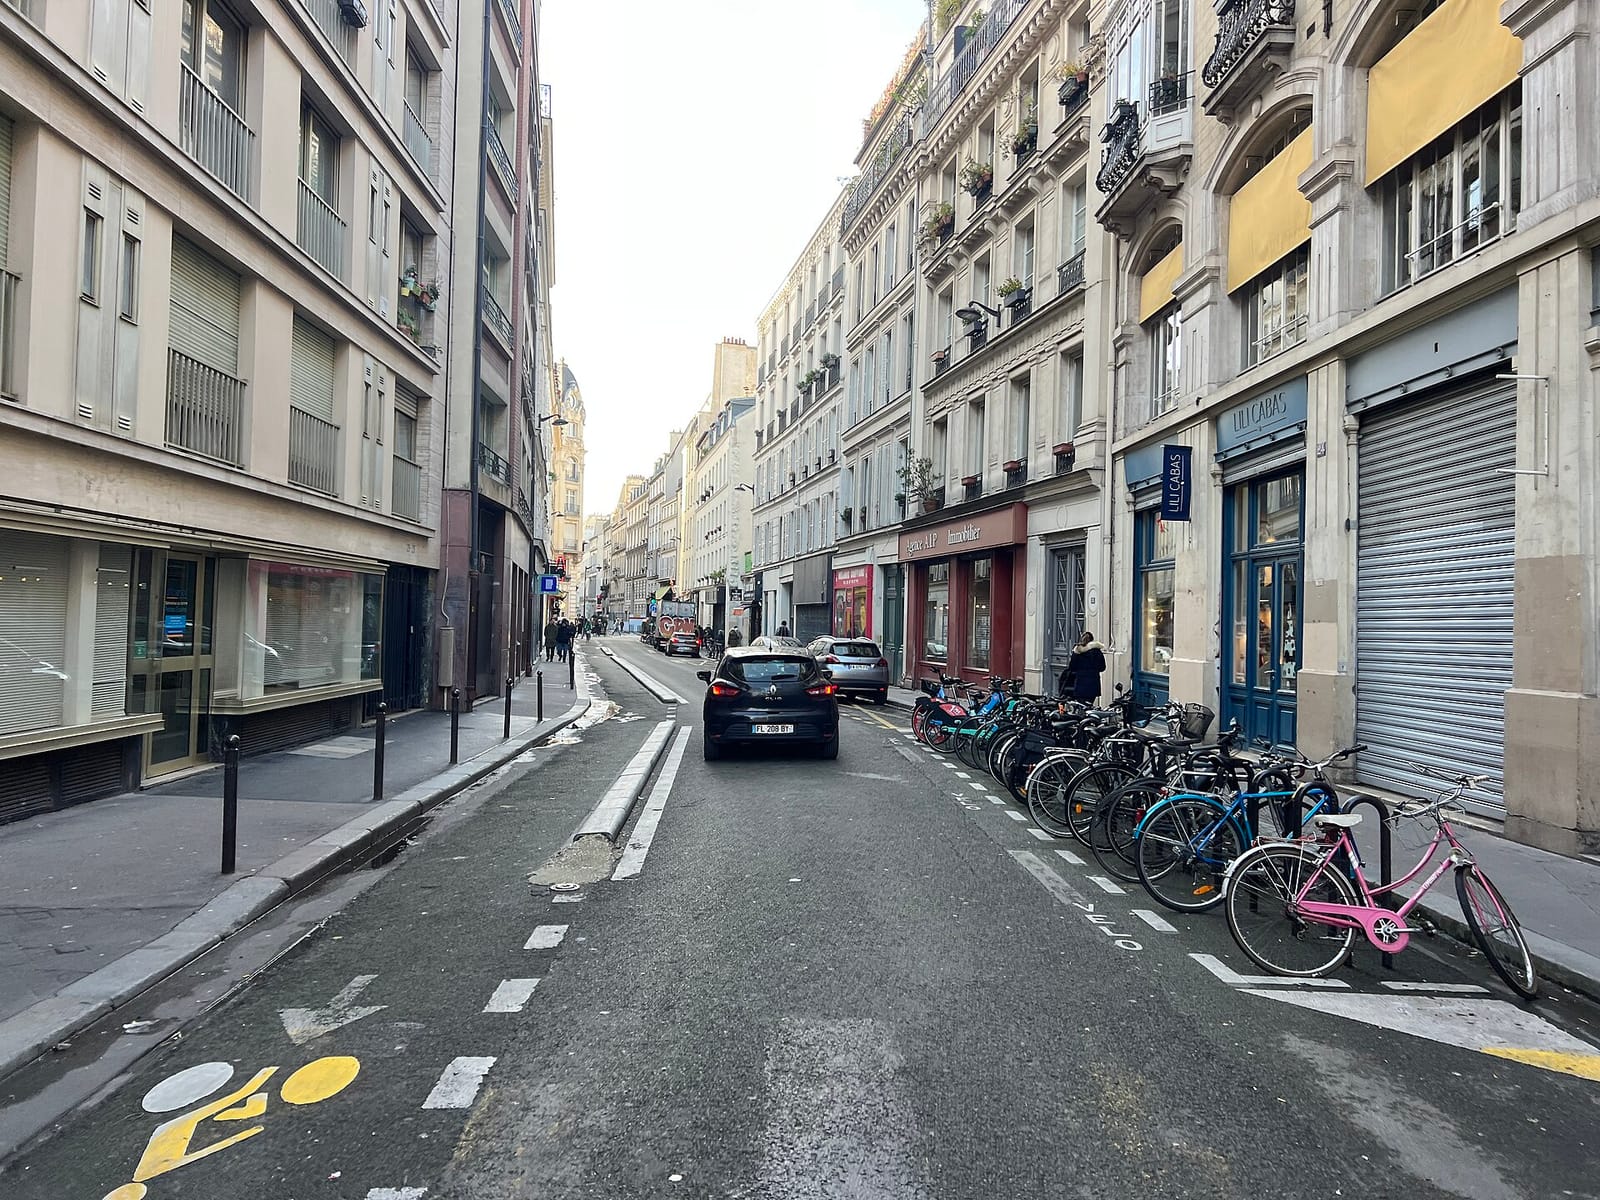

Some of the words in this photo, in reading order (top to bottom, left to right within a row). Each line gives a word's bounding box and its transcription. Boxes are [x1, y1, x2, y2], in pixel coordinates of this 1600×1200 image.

[1233, 410, 1250, 432] LILI
[1251, 391, 1287, 424] CABAS
[1169, 454, 1181, 492] CABAS
[1168, 493, 1180, 513] LILI
[947, 523, 981, 545] Immobilier
[1071, 901, 1144, 951] VELO
